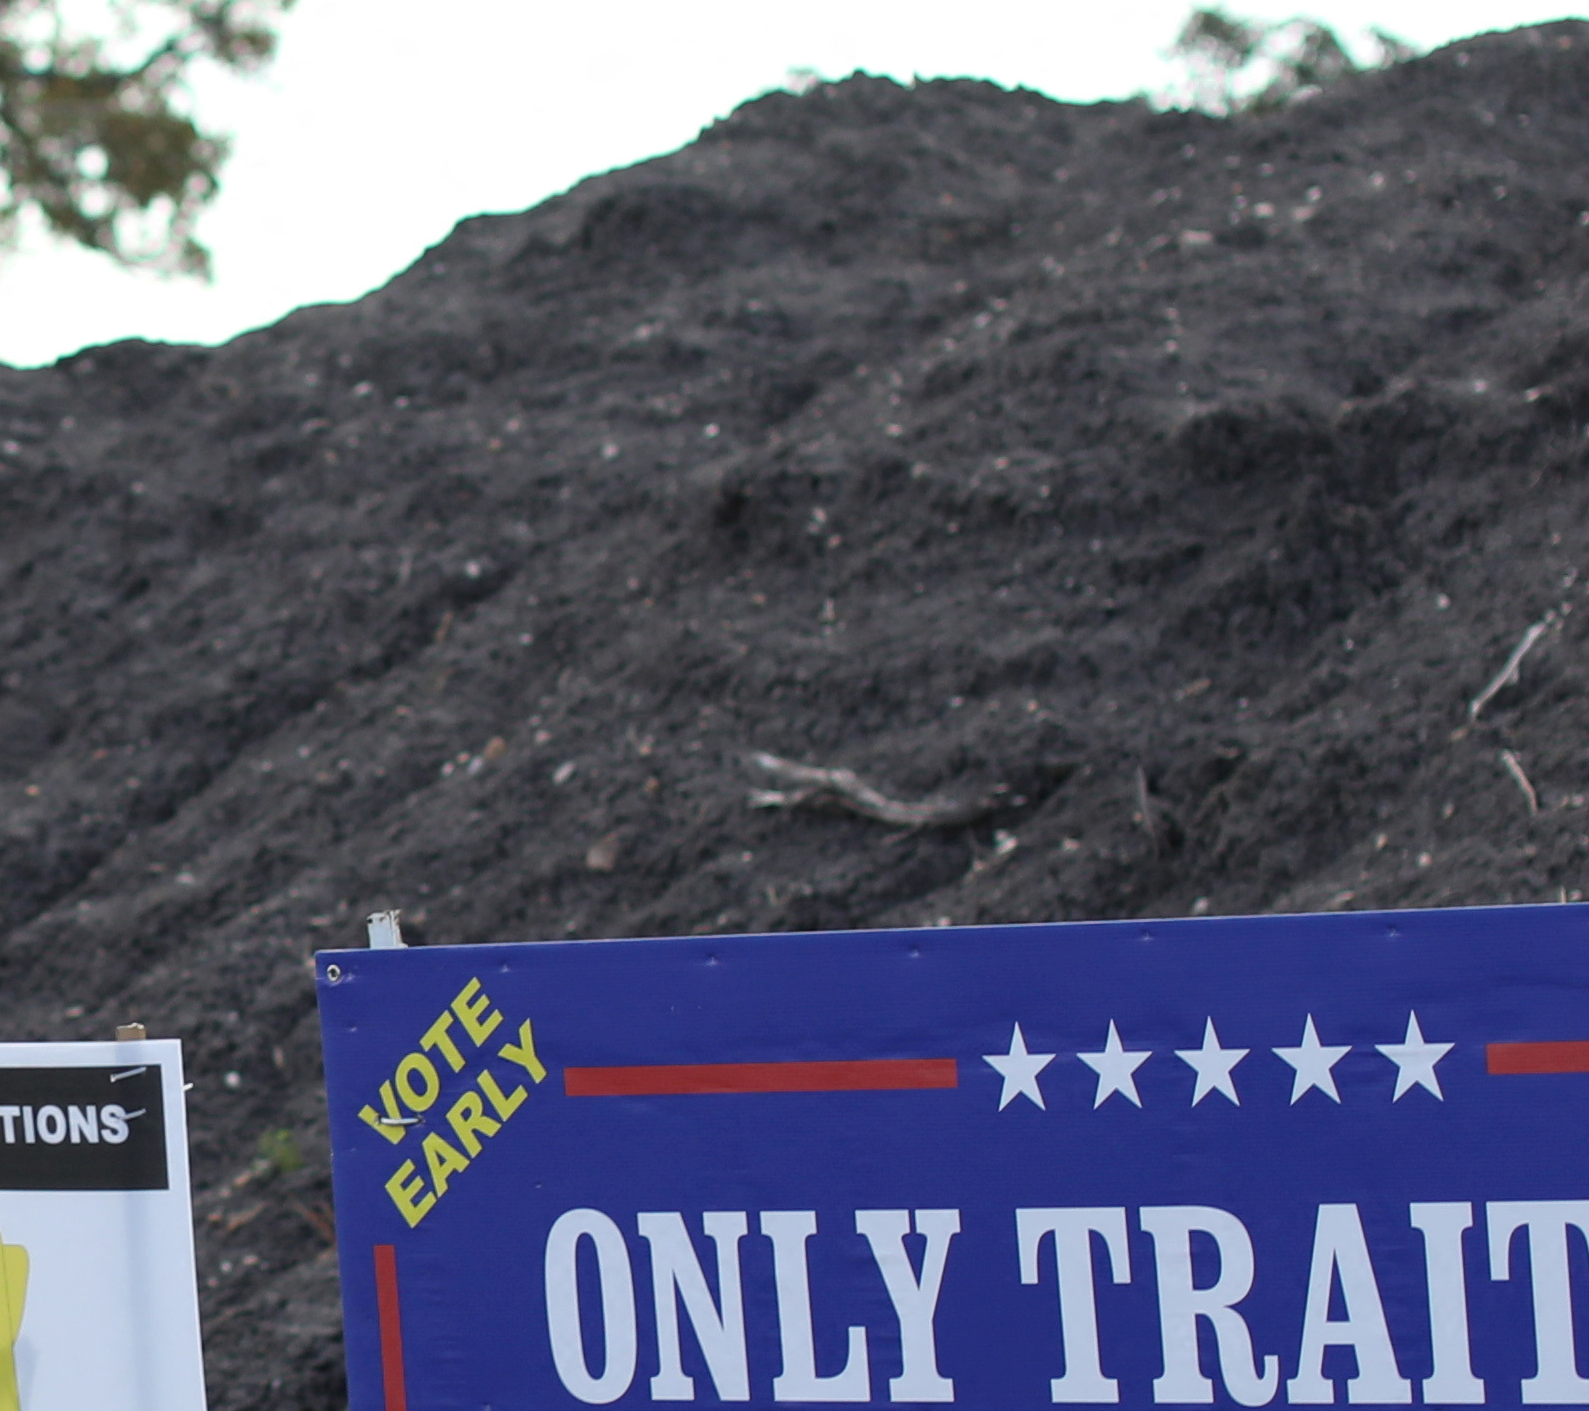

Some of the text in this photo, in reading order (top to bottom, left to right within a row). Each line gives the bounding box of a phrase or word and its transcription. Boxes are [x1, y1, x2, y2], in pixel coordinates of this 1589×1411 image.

[360, 978, 504, 1145] VOTE
[384, 1017, 547, 1227] EARLY
[544, 1208, 962, 1405] ONLY
